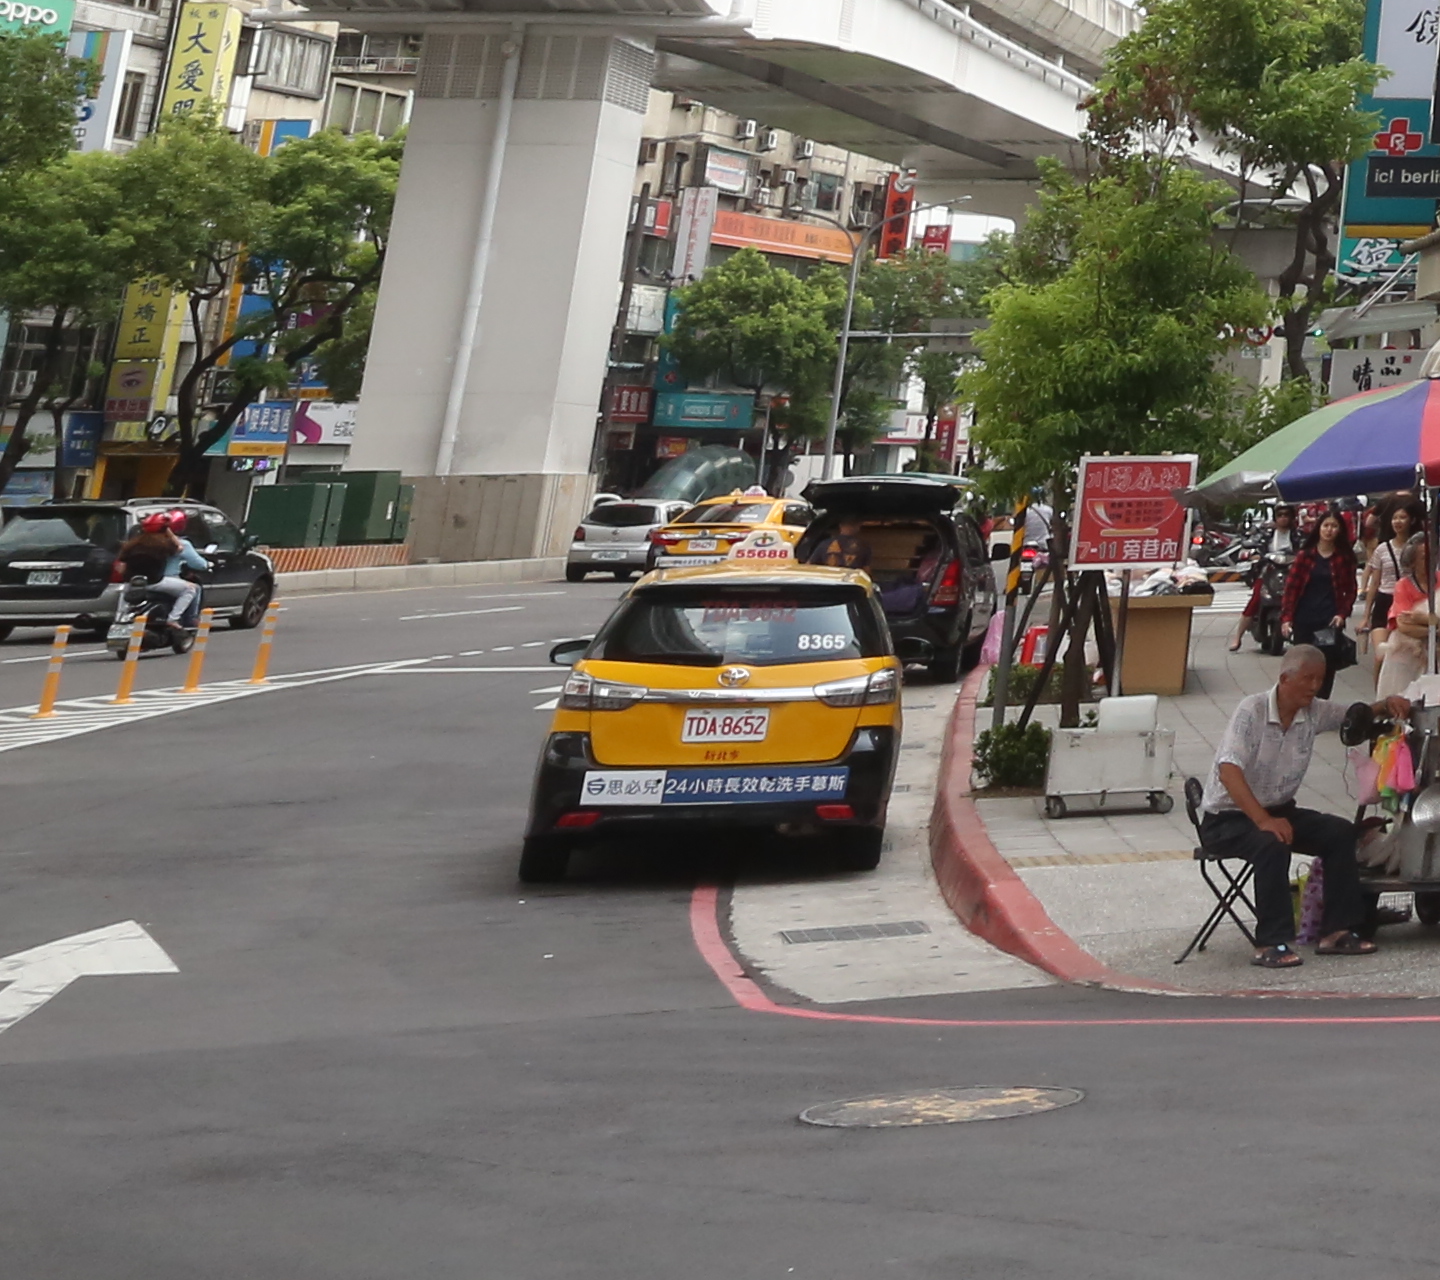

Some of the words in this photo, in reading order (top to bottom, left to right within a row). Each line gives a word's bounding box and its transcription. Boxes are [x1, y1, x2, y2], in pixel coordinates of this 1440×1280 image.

[736, 548, 789, 560] 55688
[797, 634, 846, 650] 8365
[686, 714, 768, 739] TDA-8652
